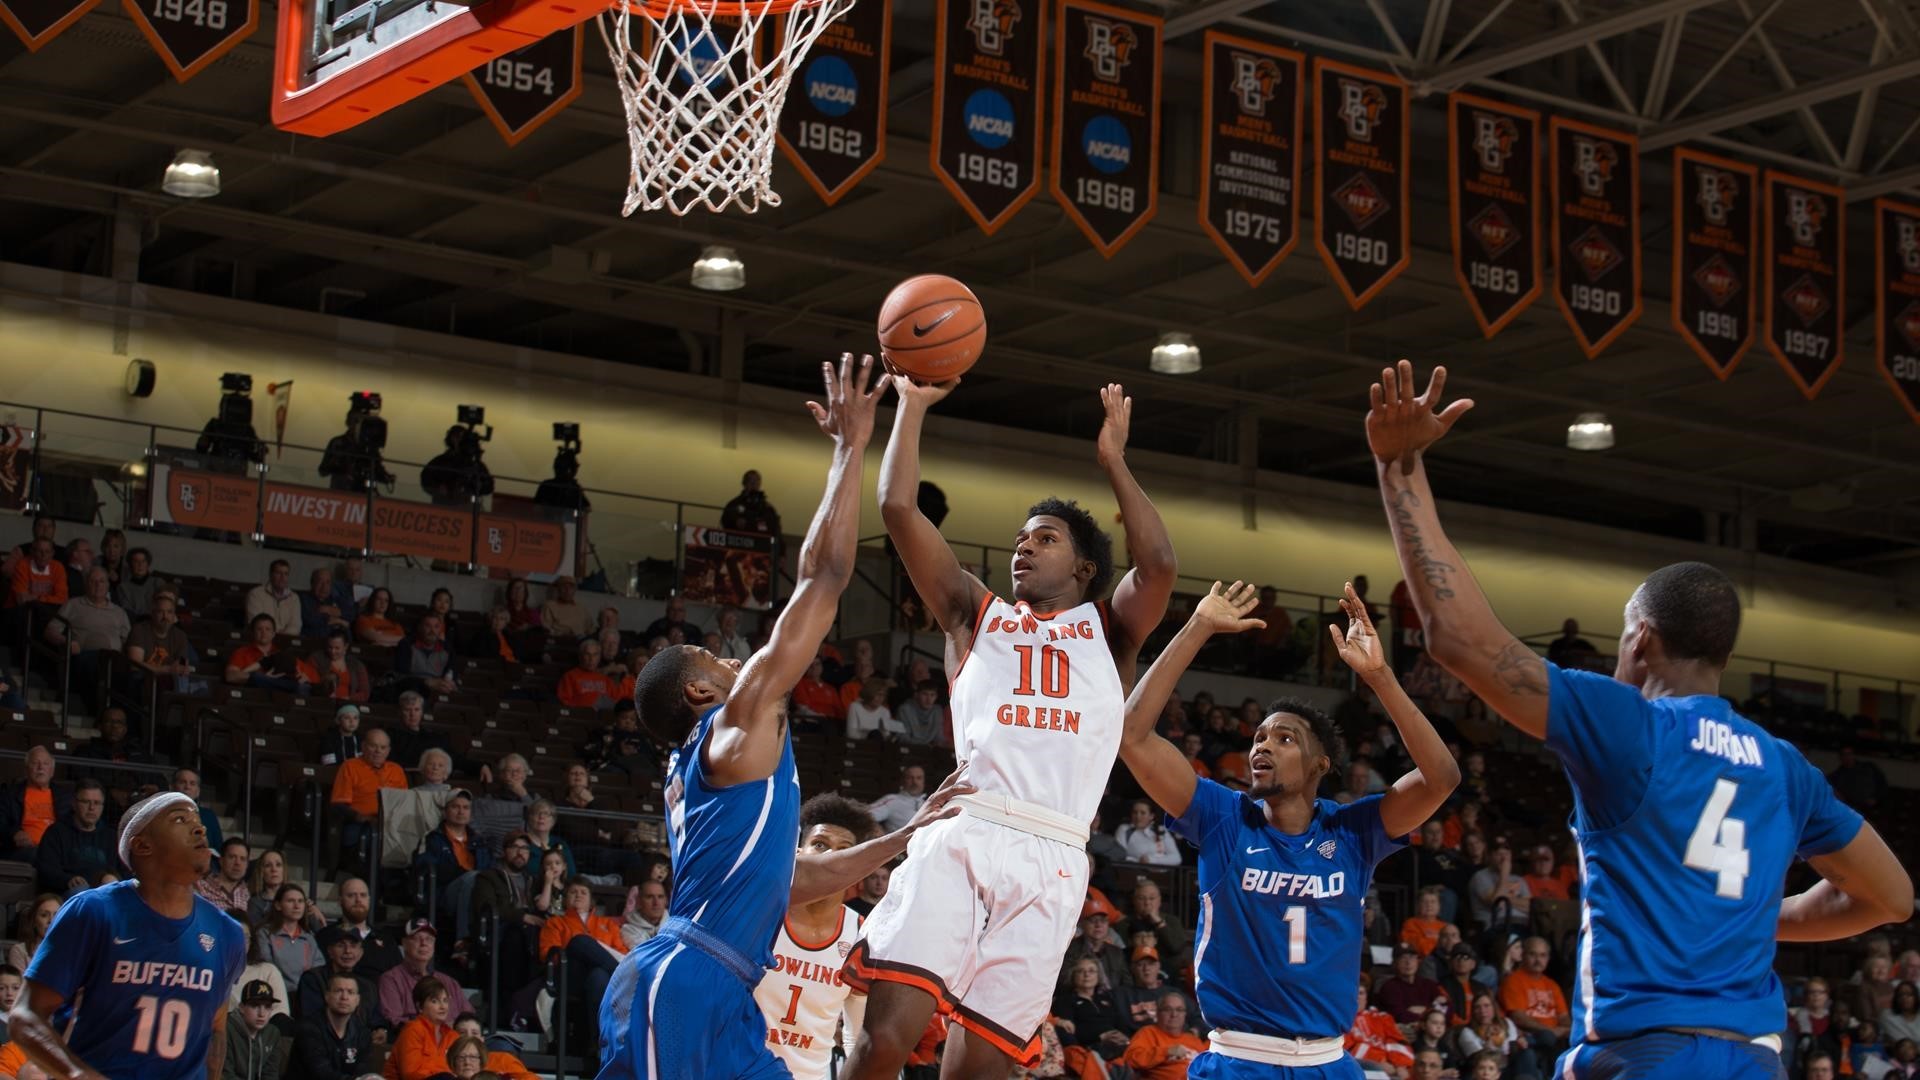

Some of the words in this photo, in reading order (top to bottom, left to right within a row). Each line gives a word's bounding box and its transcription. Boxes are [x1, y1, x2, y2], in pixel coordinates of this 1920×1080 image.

[153, 0, 228, 30] 1948
[485, 58, 555, 95] 1954
[953, 63, 1029, 91] BASKETBALL
[810, 81, 856, 106] NCAA
[1071, 90, 1146, 117] BASKETBALL
[798, 120, 862, 159] 1962
[968, 113, 1014, 138] NCAA
[1087, 139, 1131, 164] NCAA
[1230, 151, 1278, 172] NATIONAL
[957, 152, 1018, 189] 1963
[1214, 163, 1291, 191] COMMISSIONERS
[1076, 177, 1136, 213] 1968
[1219, 180, 1287, 206] INVITATIONAL
[1225, 209, 1281, 245] 1975
[1335, 232, 1388, 266] 1980
[1470, 261, 1520, 295] 1983
[1571, 284, 1621, 316] 1990
[1697, 310, 1739, 341] 1991
[1784, 328, 1830, 360] 1997
[1893, 354, 1920, 382] 20
[267, 491, 343, 520] INVEST
[343, 503, 368, 524] IN
[375, 507, 463, 537] SUCCESS
[708, 531, 727, 547] 103
[986, 613, 1094, 642] BOWING
[1013, 644, 1070, 698] 10
[997, 704, 1081, 735] GREEN
[1691, 717, 1762, 767] JORAN
[1682, 777, 1750, 900] 4
[1241, 867, 1345, 899] BUFFALO
[1282, 905, 1307, 965] 1
[112, 960, 214, 992] BUFFALO
[772, 954, 843, 987] OWLING
[780, 984, 803, 1026] 1
[131, 995, 192, 1060] 10
[765, 1027, 813, 1049] REEN
